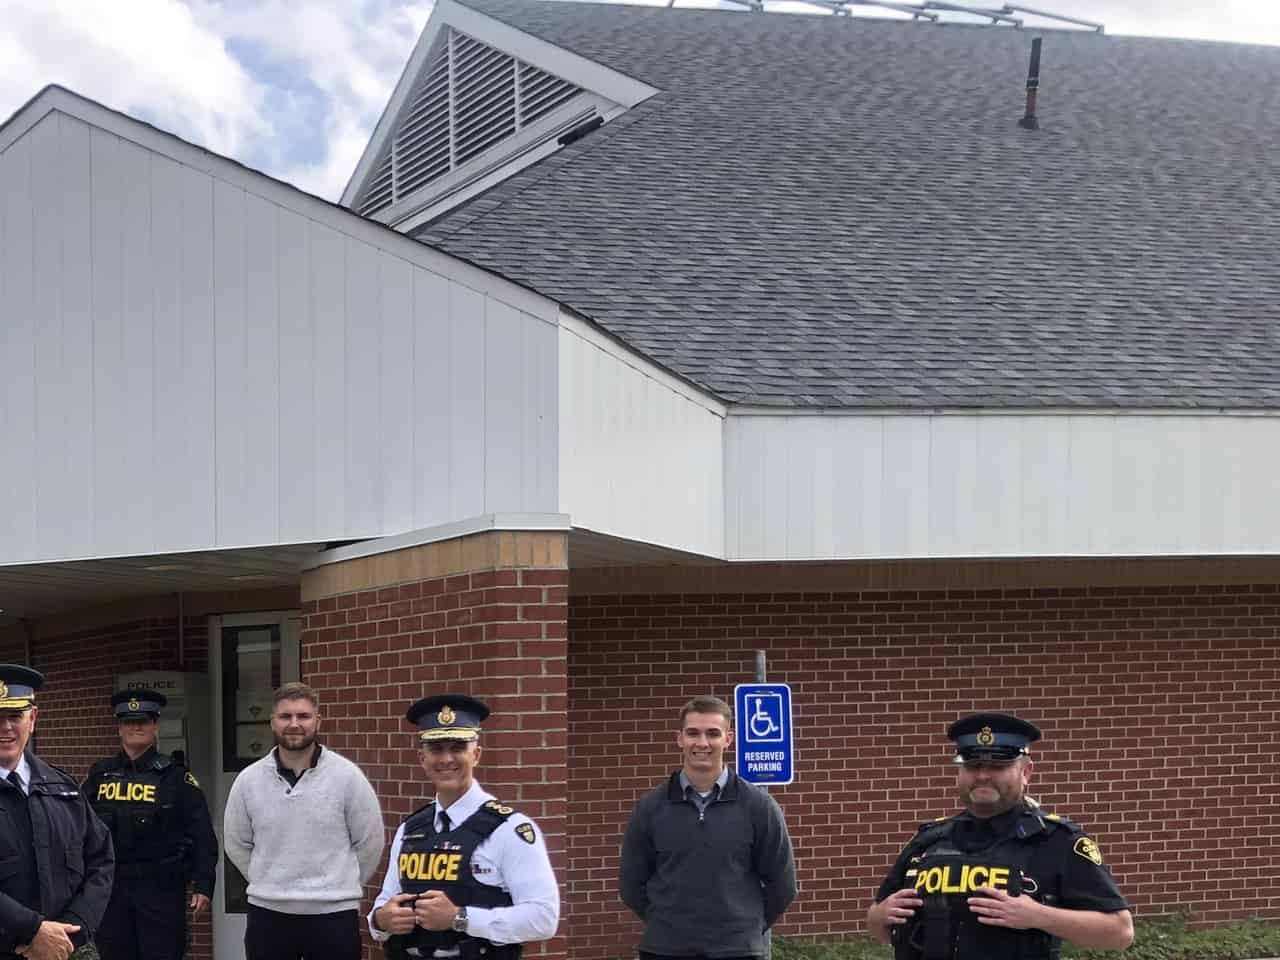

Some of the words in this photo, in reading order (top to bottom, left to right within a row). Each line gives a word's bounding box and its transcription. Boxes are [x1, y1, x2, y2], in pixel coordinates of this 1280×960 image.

[744, 751, 785, 761] RESERVED
[747, 762, 782, 773] PARKING
[97, 782, 156, 802] POLICE
[399, 852, 462, 881] POLICE
[914, 864, 1010, 894] POLICE
